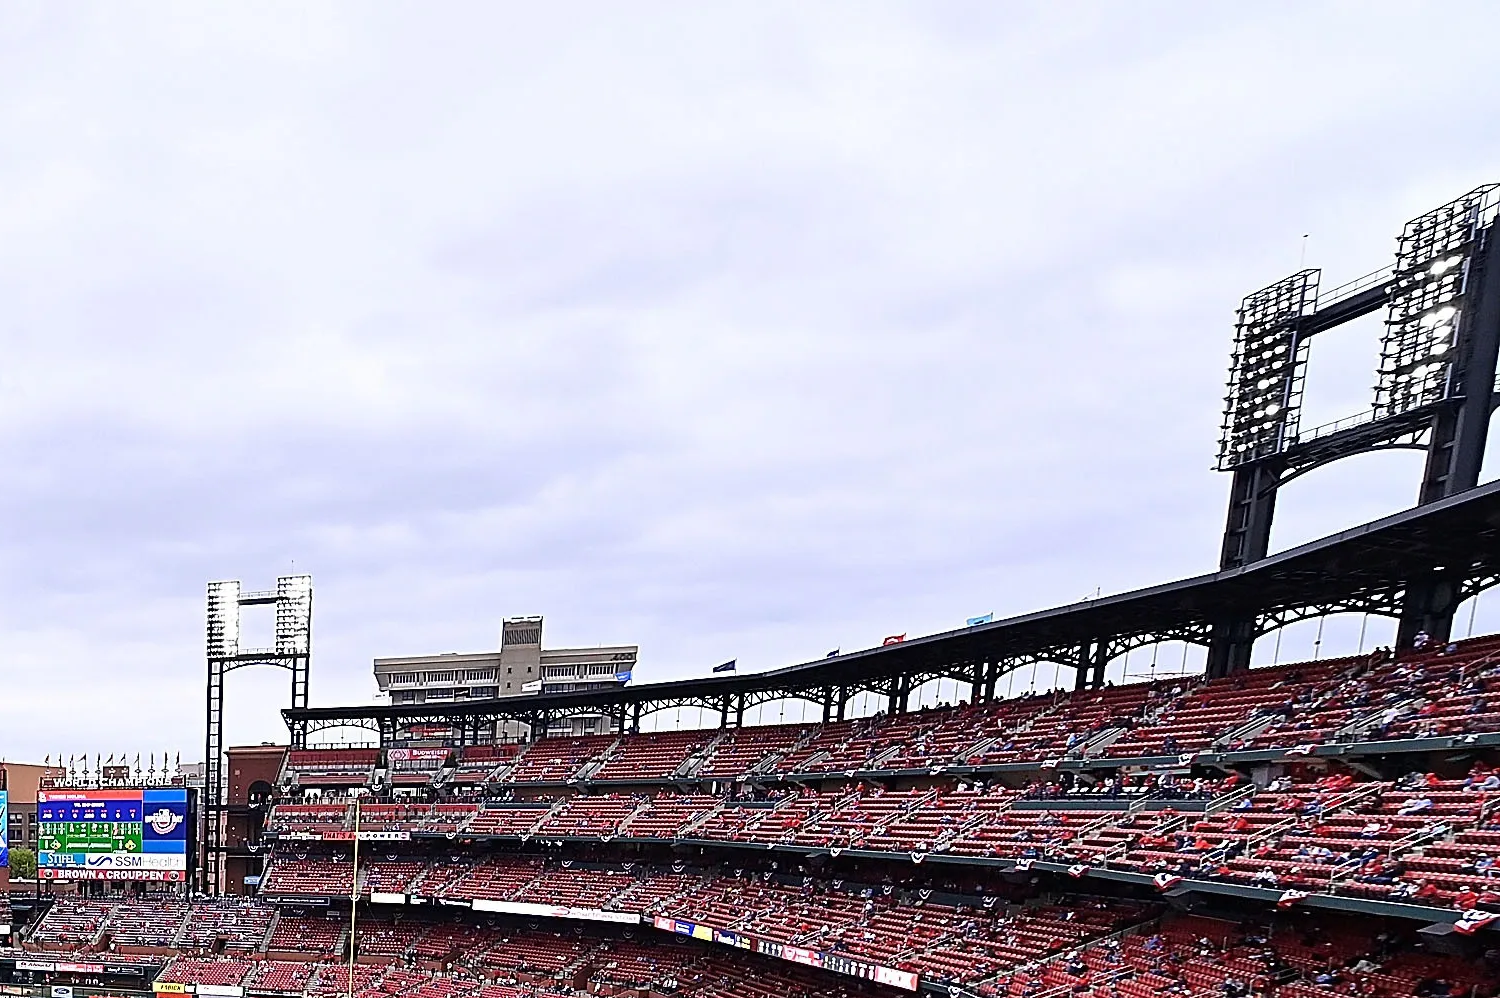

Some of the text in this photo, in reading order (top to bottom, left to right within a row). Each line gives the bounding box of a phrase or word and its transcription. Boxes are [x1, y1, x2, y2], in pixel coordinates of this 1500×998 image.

[53, 777, 172, 787] WORLD CHAMPIONS
[48, 854, 76, 864] STIFEL
[58, 870, 96, 879] BROWN
[106, 870, 164, 880] CROUPPEN
